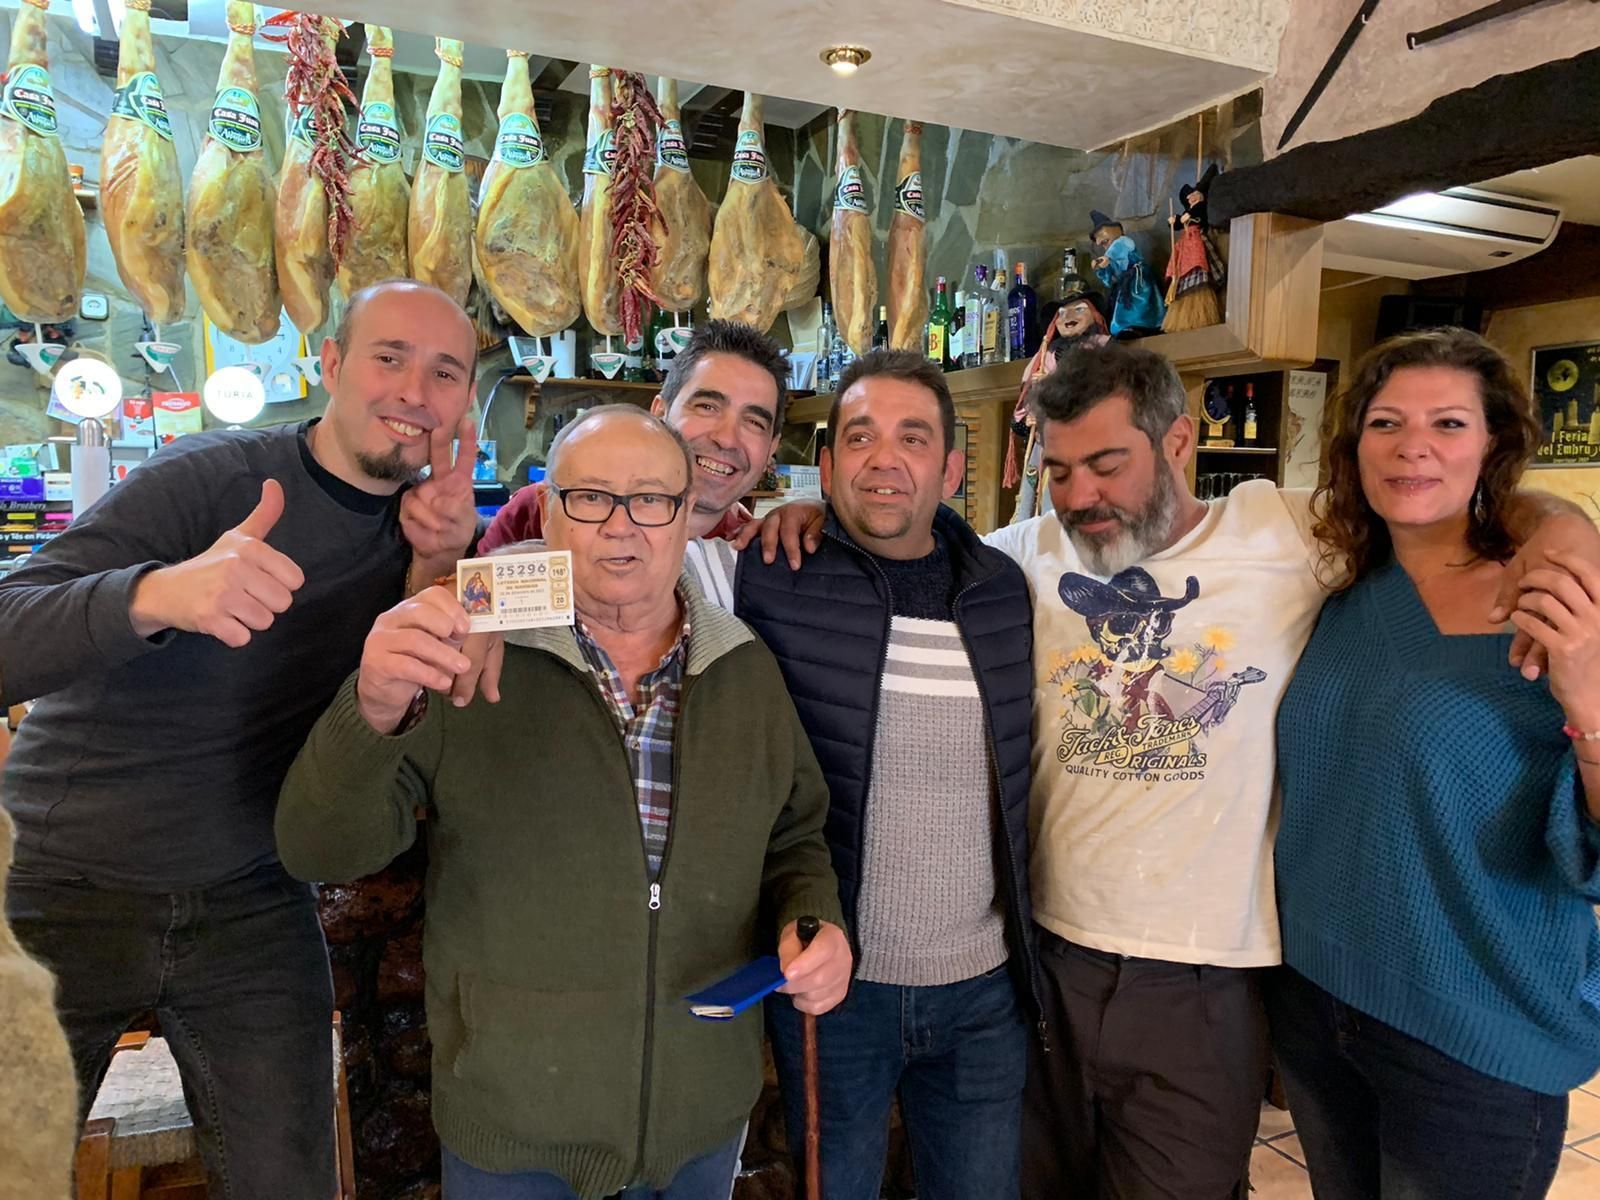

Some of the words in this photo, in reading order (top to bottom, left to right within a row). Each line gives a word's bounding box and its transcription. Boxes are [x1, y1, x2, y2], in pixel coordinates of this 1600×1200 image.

[14, 89, 40, 101] Casa
[213, 108, 237, 119] Casa
[238, 113, 259, 129] Juan
[360, 123, 381, 133] Casa
[428, 132, 450, 144] Casa
[518, 134, 538, 146] Juan
[734, 151, 750, 160] Casa
[217, 390, 253, 398] TURIA
[1559, 430, 1588, 443] Feria
[1537, 443, 1553, 456] del
[1557, 443, 1600, 458] Embruj
[10, 501, 47, 511] Brothers
[496, 563, 546, 577] 25296
[556, 596, 564, 604] 20
[1142, 730, 1192, 751] TRADEMARK
[1065, 764, 1110, 779] QUALITY
[1113, 770, 1160, 782] COTTON
[1163, 770, 1205, 783] GOODS
